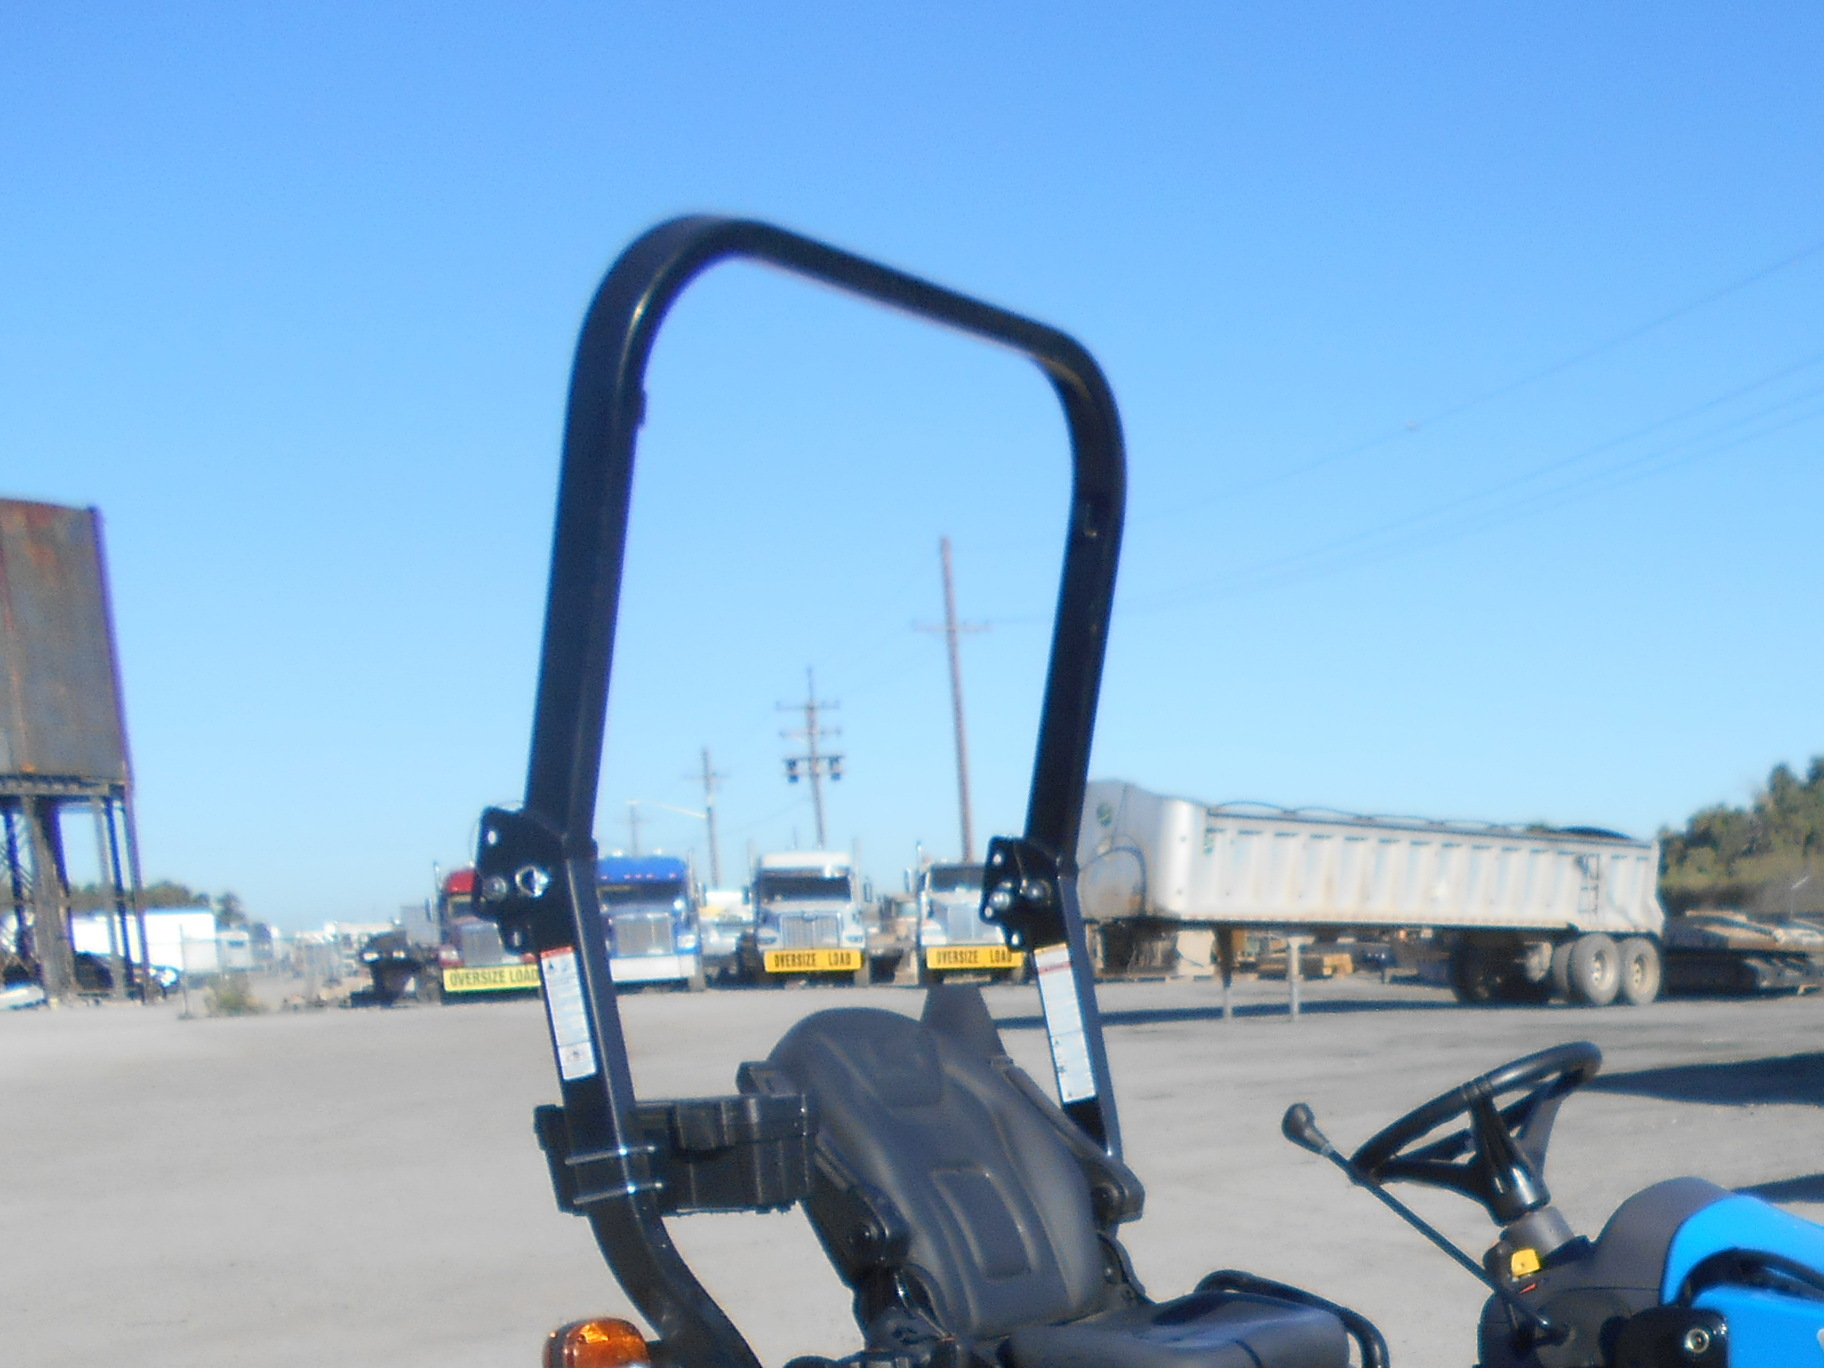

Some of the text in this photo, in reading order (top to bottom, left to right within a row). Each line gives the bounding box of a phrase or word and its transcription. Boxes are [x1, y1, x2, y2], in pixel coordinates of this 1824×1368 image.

[774, 951, 852, 967] OVERSIZE LOAD
[936, 948, 1013, 964] OVERSIZE LOAD
[449, 967, 540, 986] OVERSIZE LOAD
